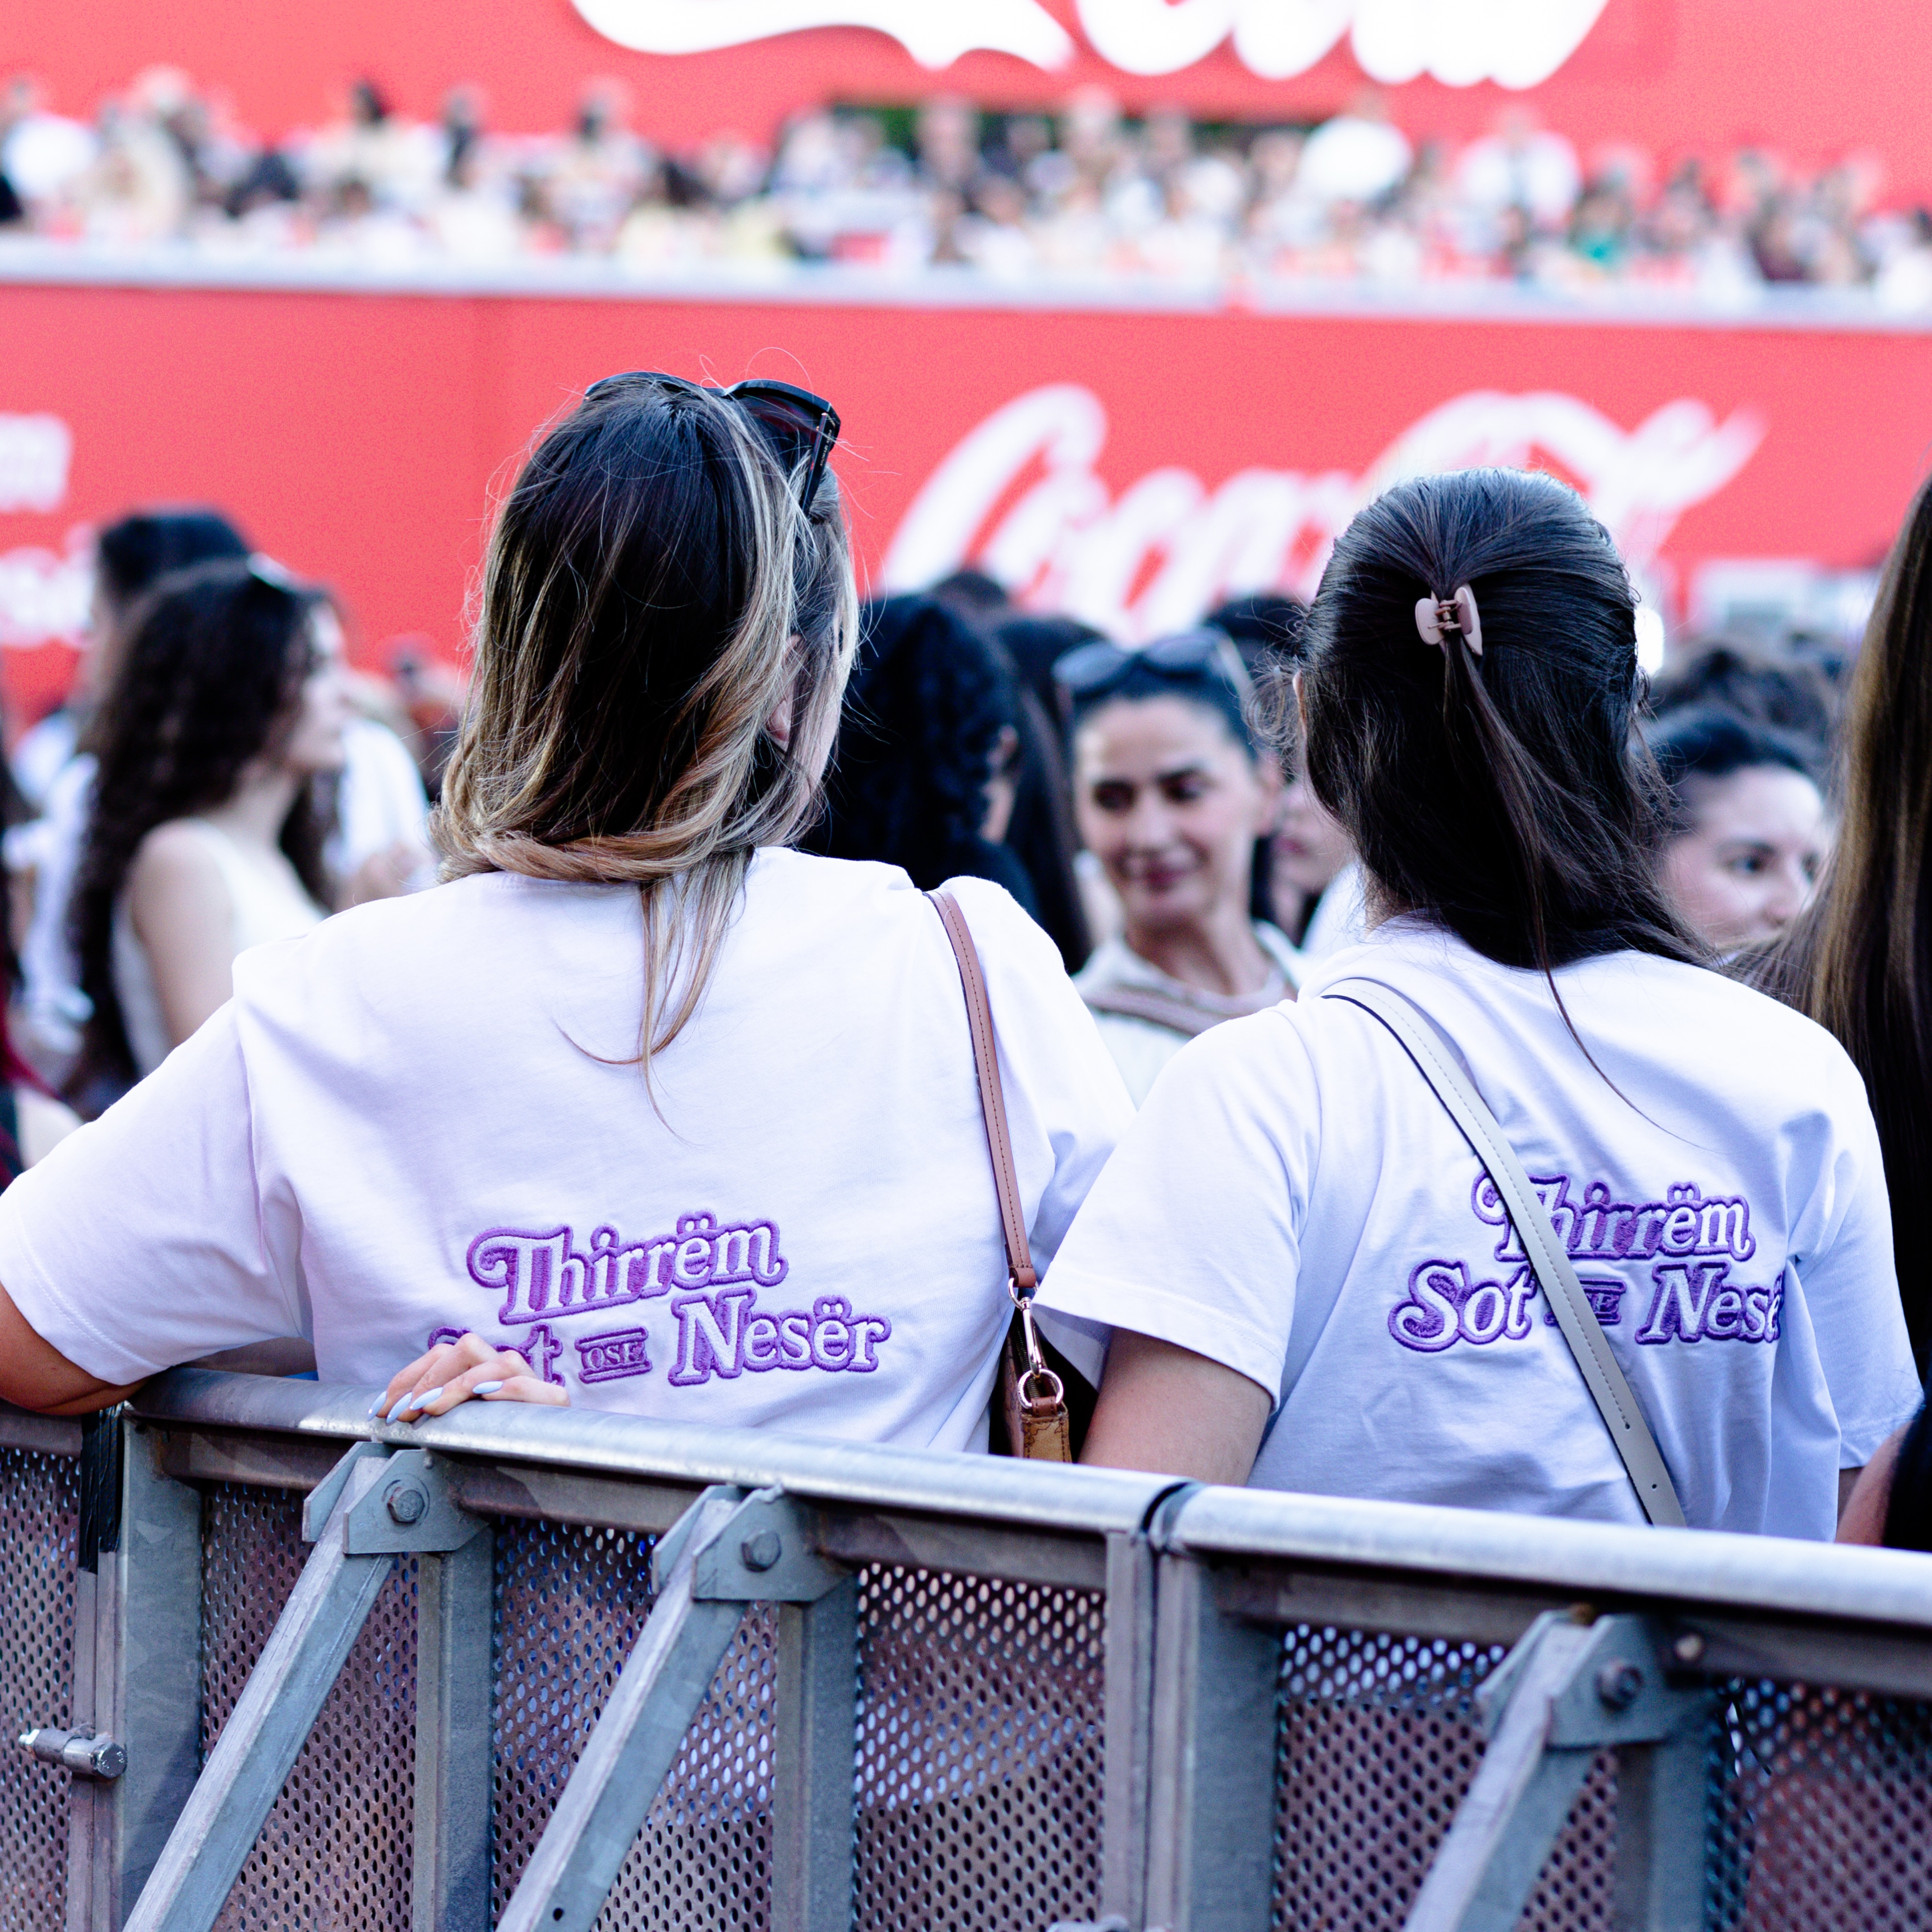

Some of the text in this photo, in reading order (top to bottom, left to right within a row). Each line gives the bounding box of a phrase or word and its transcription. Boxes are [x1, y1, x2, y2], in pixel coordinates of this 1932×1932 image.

[466, 1210, 789, 1324] Thirrëm
[1388, 1257, 1537, 1352] Sot
[581, 1338, 648, 1372] OSE
[668, 1287, 892, 1387] Nesër
